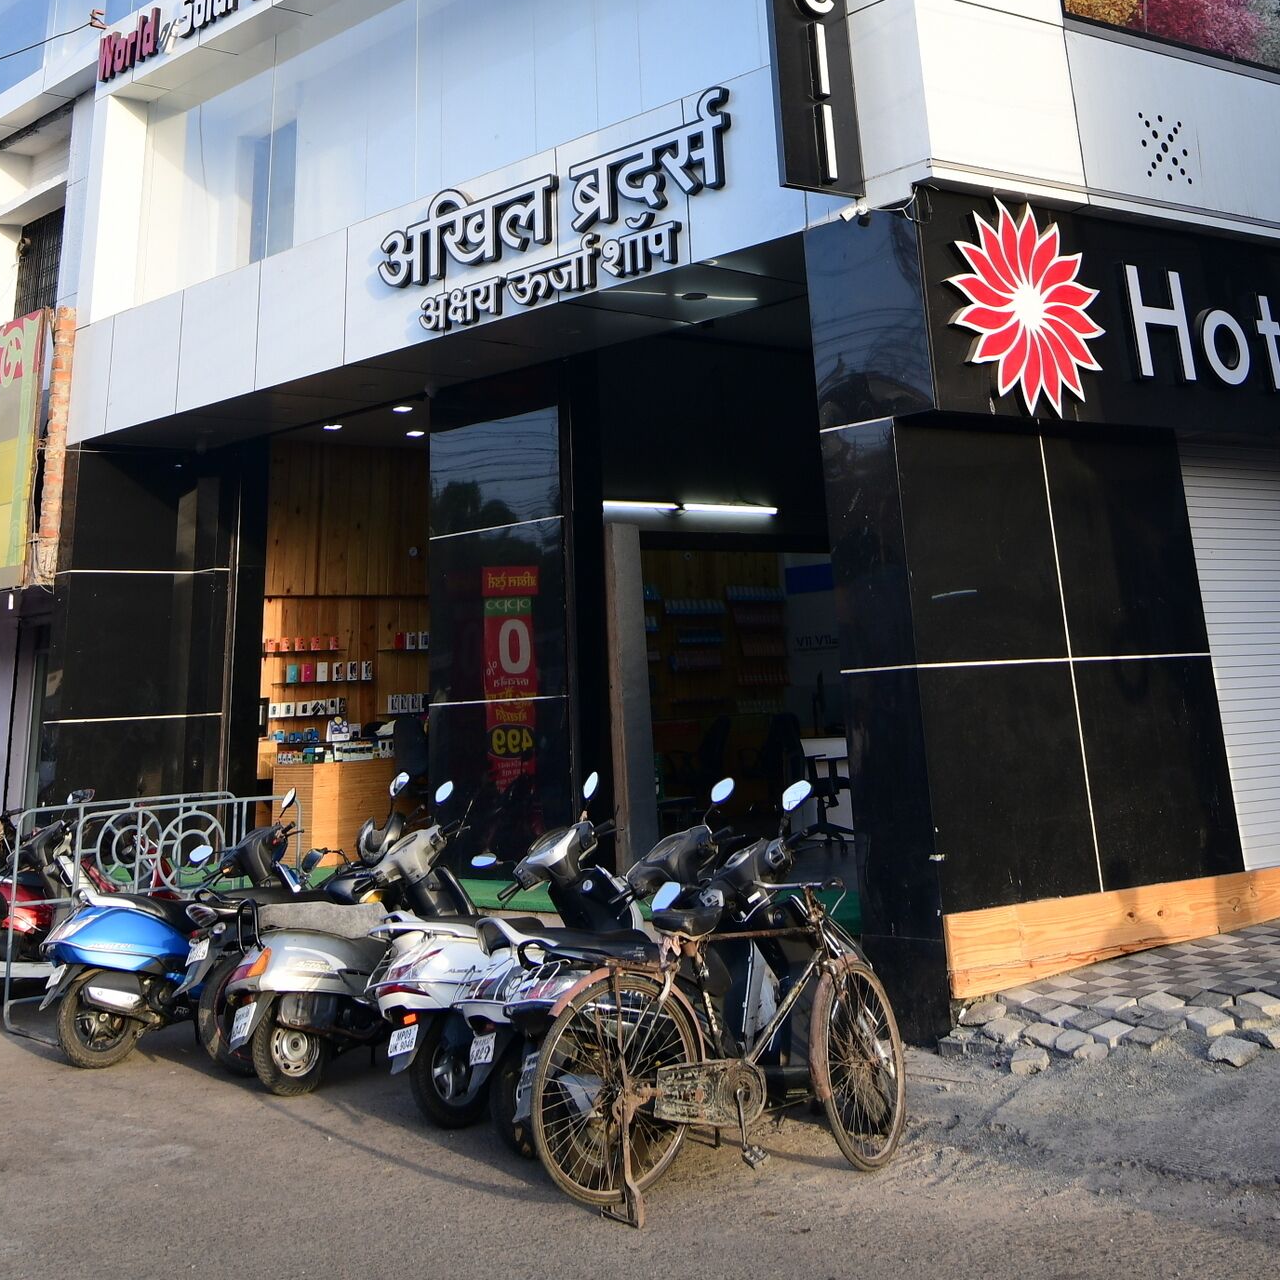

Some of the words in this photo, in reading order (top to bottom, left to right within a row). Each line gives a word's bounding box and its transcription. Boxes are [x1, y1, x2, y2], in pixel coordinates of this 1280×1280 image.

[98, 7, 161, 83] World
[377, 173, 559, 288] अखिल
[569, 85, 731, 232] ब्रदर्स
[419, 275, 506, 332] अक्षय
[506, 232, 601, 307] ऊर्जा
[601, 212, 682, 278] शॉप
